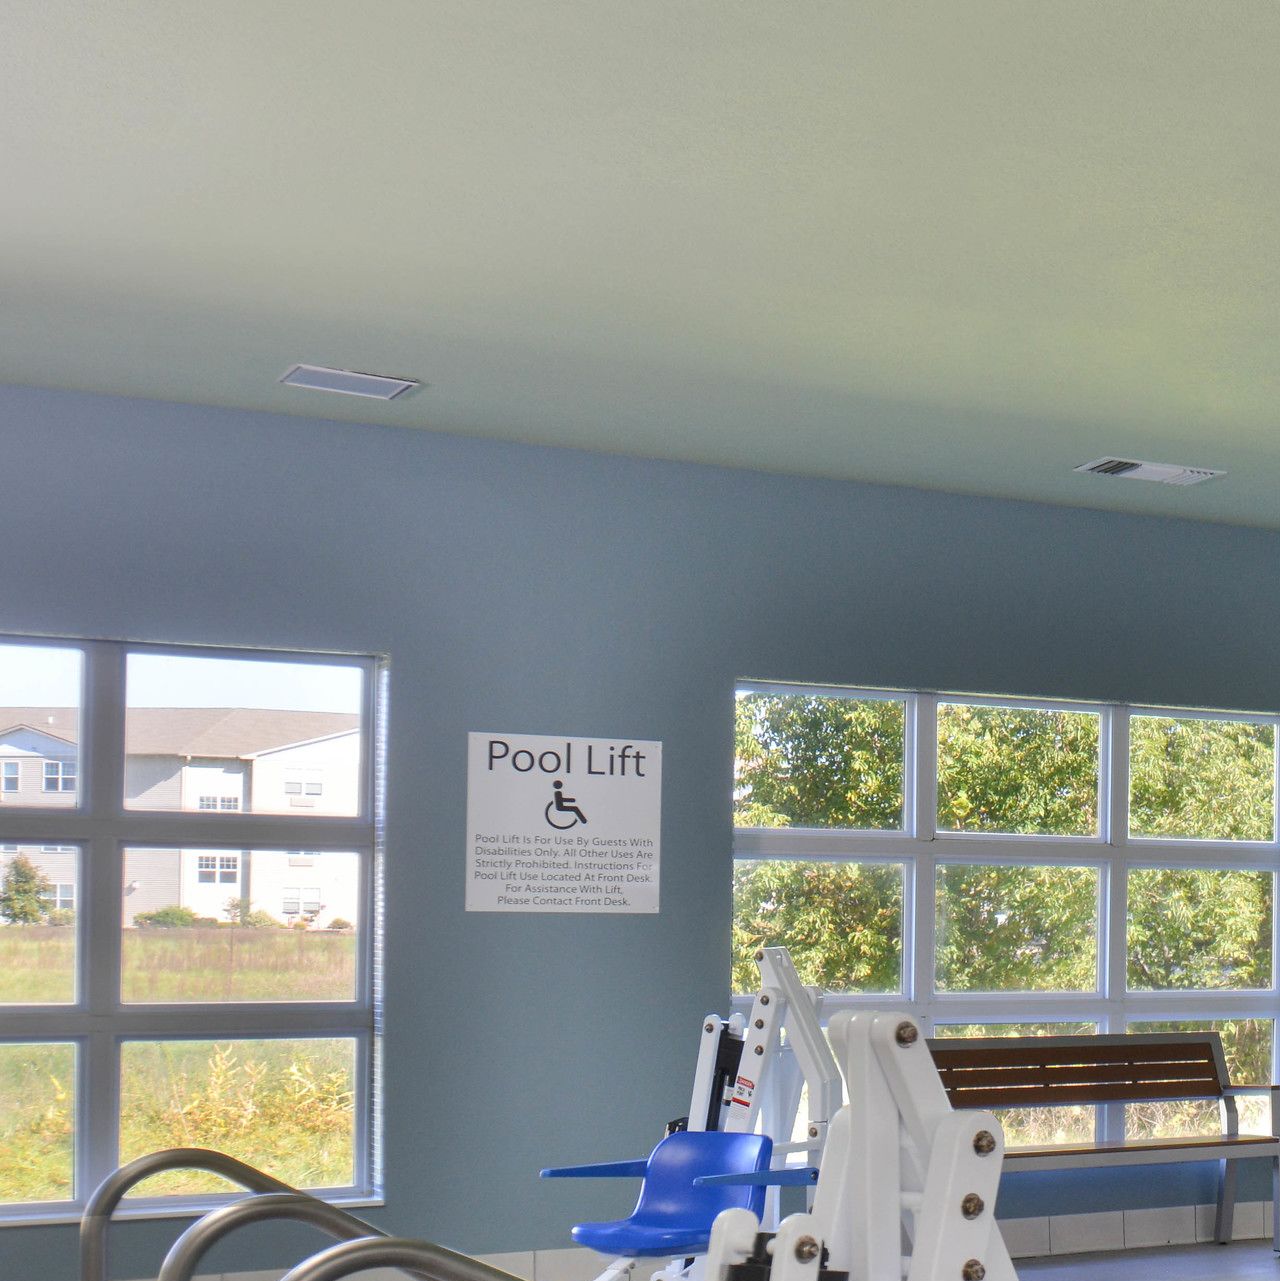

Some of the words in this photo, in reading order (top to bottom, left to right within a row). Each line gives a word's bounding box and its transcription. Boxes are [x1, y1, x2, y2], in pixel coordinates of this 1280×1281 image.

[488, 740, 571, 774] Pool
[587, 745, 646, 777] Lift
[475, 834, 499, 843] Pool
[502, 835, 520, 843] Lift
[523, 836, 531, 844] Is
[534, 836, 551, 844] For
[554, 836, 573, 845] Use
[576, 837, 589, 847] By
[592, 837, 627, 846] Guests
[629, 838, 654, 847] With
[474, 846, 532, 856] Disabilities
[534, 847, 560, 858] Only.
[563, 848, 576, 857] All
[579, 849, 608, 858] Other
[610, 849, 634, 858] Uses
[636, 850, 653, 859] Are
[475, 859, 512, 870] Strictly
[574, 861, 634, 870] Instructions
[637, 862, 652, 870] For
[474, 871, 497, 880] Pool
[500, 871, 517, 880] Lift
[520, 872, 538, 881] Use
[541, 872, 581, 881] Located
[584, 873, 595, 881] At
[597, 873, 624, 882] Front
[505, 884, 521, 892] For
[525, 885, 577, 893] Assistance
[579, 885, 602, 893] With
[497, 896, 530, 904] Please
[533, 896, 573, 905] Contact
[575, 897, 603, 905] Front
[604, 897, 631, 906] Desk.
